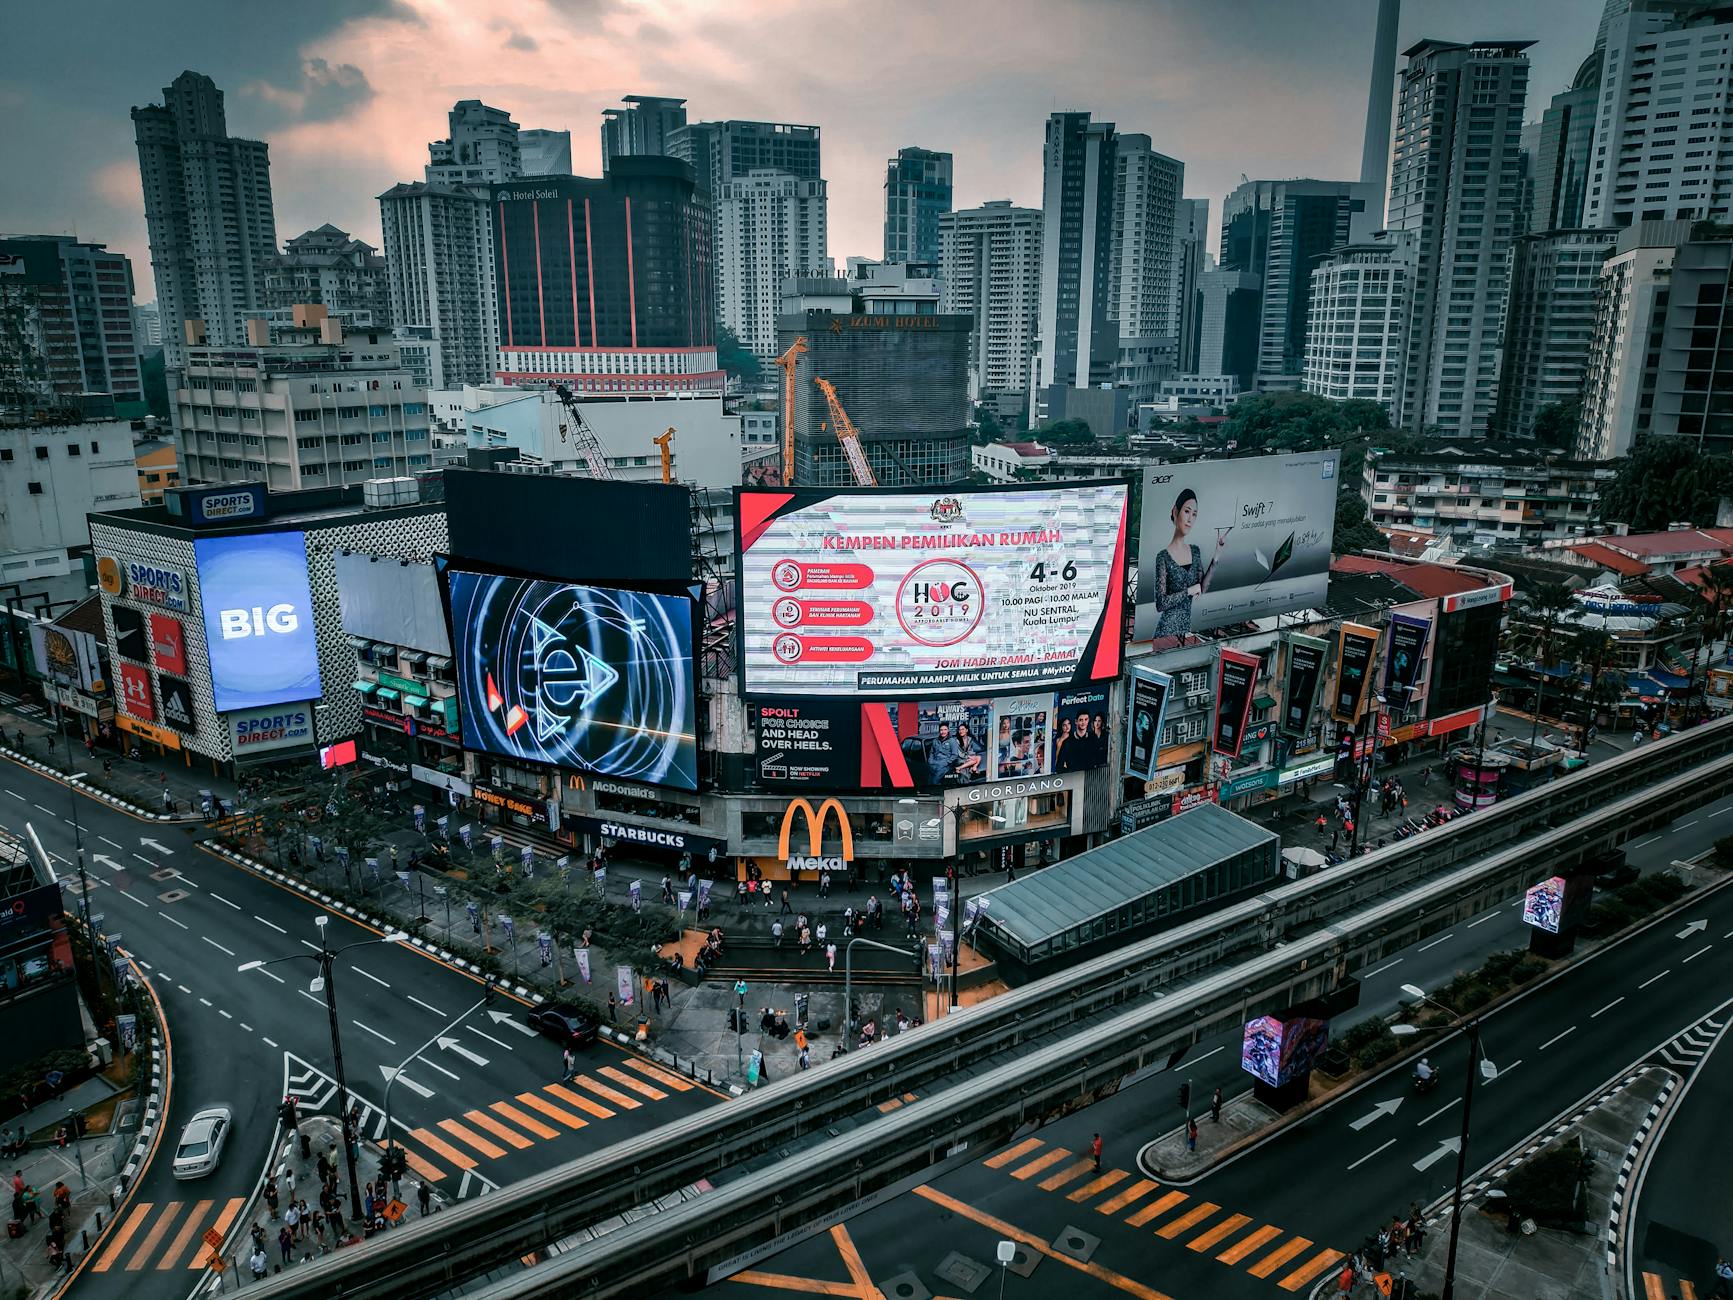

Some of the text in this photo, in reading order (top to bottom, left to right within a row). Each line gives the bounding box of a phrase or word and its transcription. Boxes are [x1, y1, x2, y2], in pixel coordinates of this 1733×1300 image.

[513, 189, 558, 200] Hotel Soleil
[851, 316, 939, 328] IZUMI HOTEL
[1151, 473, 1173, 484] acer
[206, 494, 250, 509] SPORTS
[1242, 501, 1274, 518] Swift 7
[1264, 519, 1277, 529] yang
[823, 530, 1060, 549] KEMPEN PEMILIKAN RUMAH
[130, 563, 181, 593] SPORTS
[1030, 562, 1046, 583] 4
[1062, 560, 1077, 581] 6
[1029, 582, 1077, 593] Oktober 2019
[1002, 598, 1023, 606] 10.00
[1024, 596, 1043, 605] PAGI
[1050, 595, 1069, 603] 10.00
[1071, 592, 1099, 600] MALAM
[914, 604, 969, 617] 2019
[1024, 605, 1080, 617] NU SENTRAL,
[220, 603, 298, 640] BIG
[1023, 615, 1080, 626] Kuala Lumpur
[935, 660, 960, 669] JOM
[963, 657, 997, 667] HADIR
[999, 654, 1034, 665] RAMAI
[1044, 650, 1076, 661] RAMAI
[861, 664, 1076, 685] PERUMAHAN MAMPU MILIK UNTUK SEMUA #MyHOC
[1061, 695, 1087, 706] Perfect
[1087, 694, 1105, 702] Date
[761, 708, 799, 717] SPOILT
[937, 704, 965, 714] ALWAYS
[945, 711, 970, 721] MAYBE
[236, 713, 305, 733] SPORTS
[761, 718, 829, 729] FOR CHOICE
[762, 729, 819, 739] AND HEAD
[762, 740, 832, 750] OVER HEELS.
[1299, 764, 1321, 776] FamilyMart
[592, 781, 656, 799] McDonald's
[968, 778, 1063, 801] GIORDANO
[1235, 778, 1263, 791] watsons
[474, 788, 506, 806] HONEY
[1159, 803, 1170, 811] CITY
[601, 824, 685, 848] STARBUCKS
[718, 1258, 741, 1272] GREAT
[750, 1244, 773, 1258] LIVING
[774, 1237, 786, 1247] THE
[786, 1226, 812, 1242] LEGACY
[813, 1218, 823, 1228] OF
[824, 1212, 840, 1222] YOUR
[840, 1201, 861, 1216] LOVED
[861, 1193, 878, 1204] ONES
